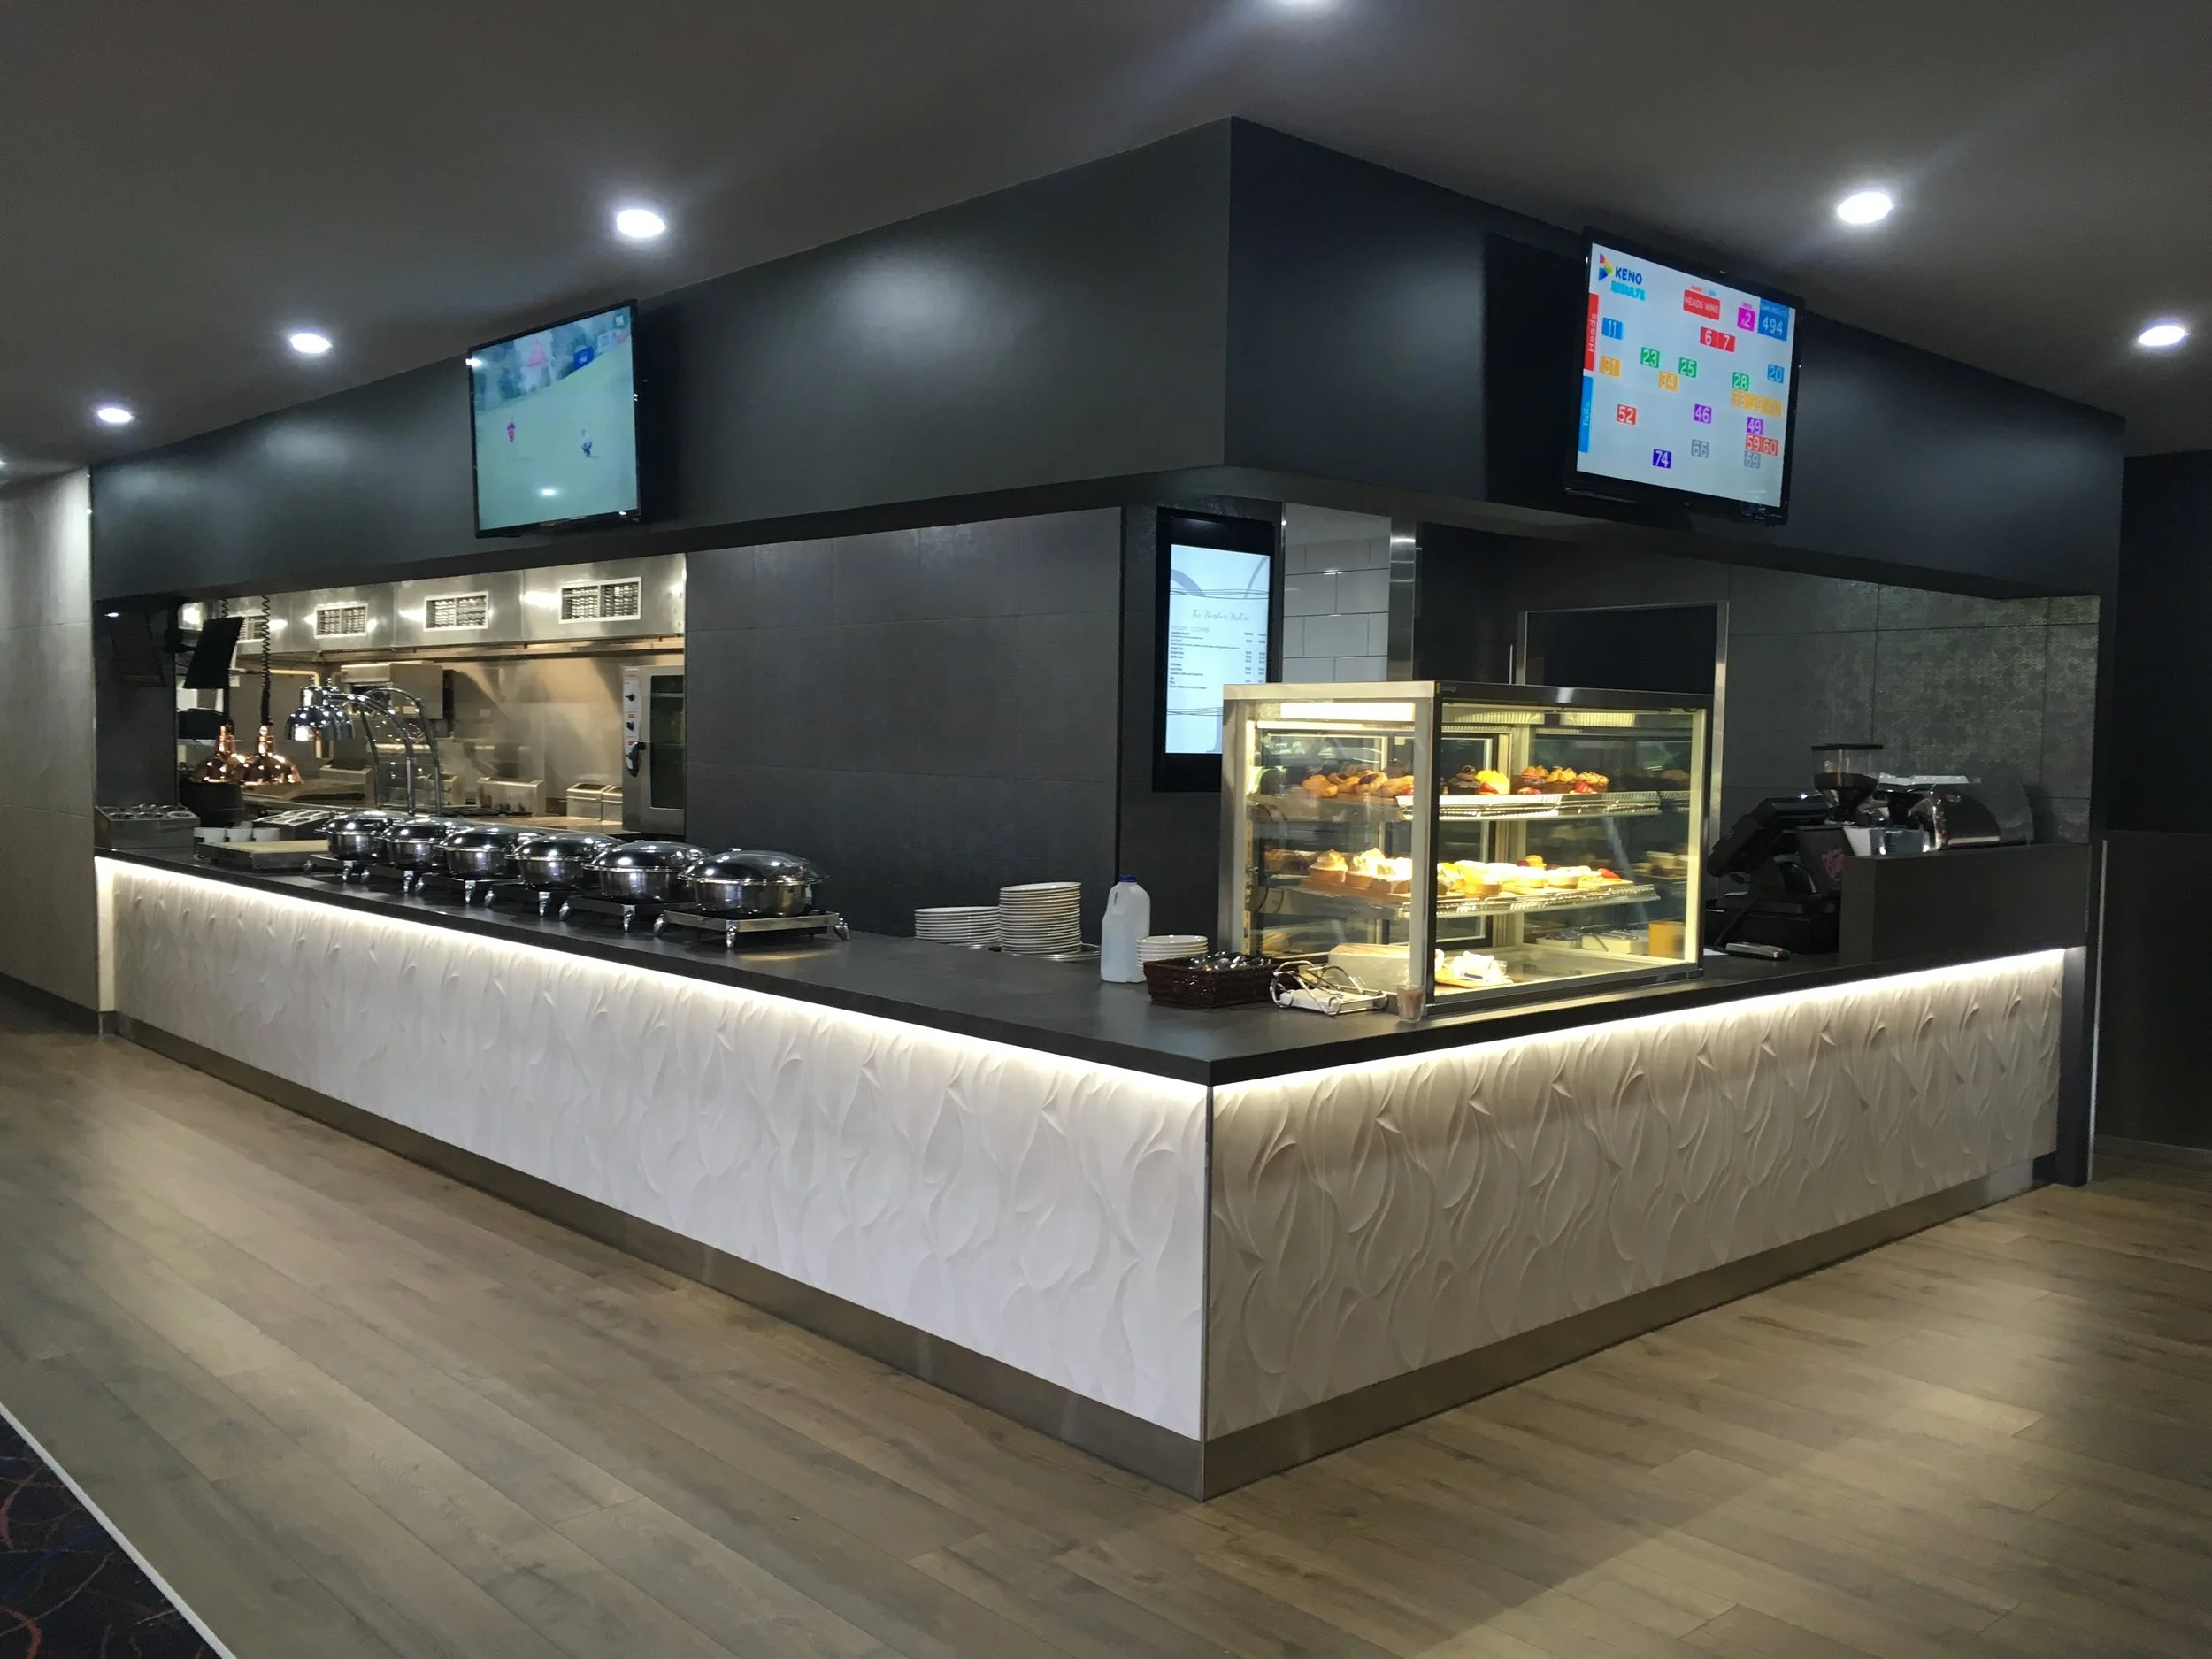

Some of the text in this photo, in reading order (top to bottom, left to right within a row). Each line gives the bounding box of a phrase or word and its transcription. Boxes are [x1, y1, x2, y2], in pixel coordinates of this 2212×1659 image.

[1615, 266, 1643, 285] KENO
[1587, 313, 1598, 352] Heads
[1762, 316, 1783, 336] 494
[1603, 357, 1617, 376] 31
[1642, 349, 1658, 367] 23
[1680, 358, 1695, 377] 25
[1769, 365, 1783, 382] 20
[1662, 373, 1675, 389] 34
[1733, 373, 1748, 390] 28
[1733, 390, 1747, 407] 38
[1582, 401, 1591, 426] Tails
[1618, 405, 1634, 424] 52
[1694, 406, 1710, 424] 46
[1747, 419, 1762, 434] 49
[1692, 441, 1709, 457] 66
[1746, 434, 1777, 455] 59 60
[1655, 449, 1669, 468] 74
[1745, 451, 1759, 467] 69
